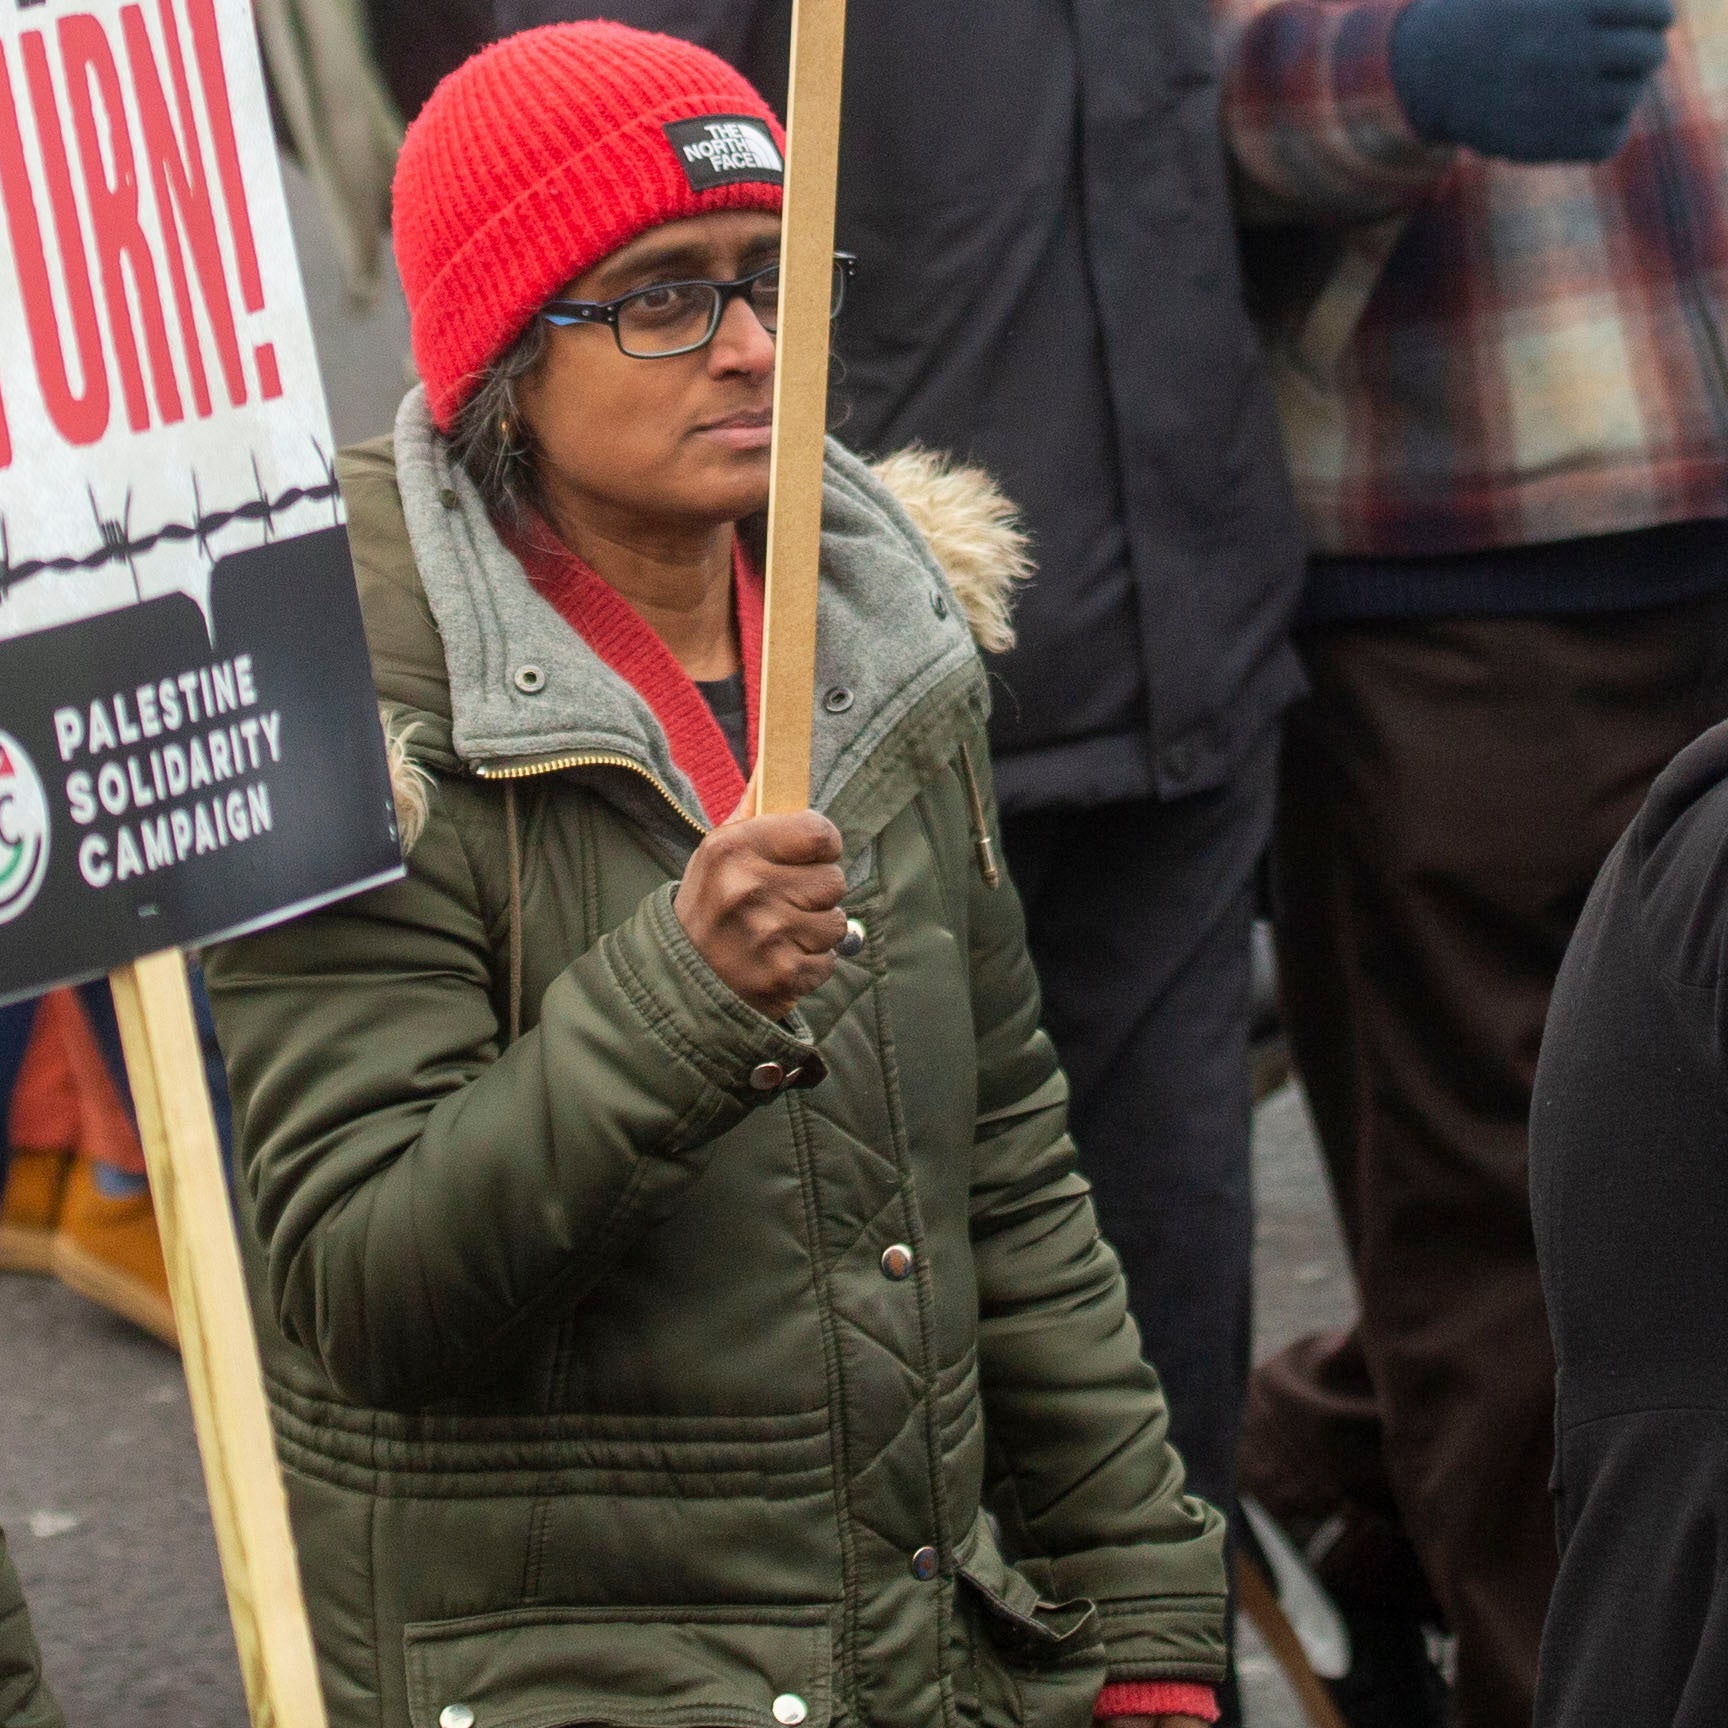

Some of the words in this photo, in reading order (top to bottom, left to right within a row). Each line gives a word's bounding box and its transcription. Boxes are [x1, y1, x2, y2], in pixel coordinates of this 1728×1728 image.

[682, 138, 749, 163] NORTH
[703, 122, 741, 141] THE
[709, 152, 758, 173] FACE
[52, 653, 259, 763] PALESTINE
[65, 709, 283, 825] SOLIDARITY
[78, 781, 274, 889] CAMPAIGN
